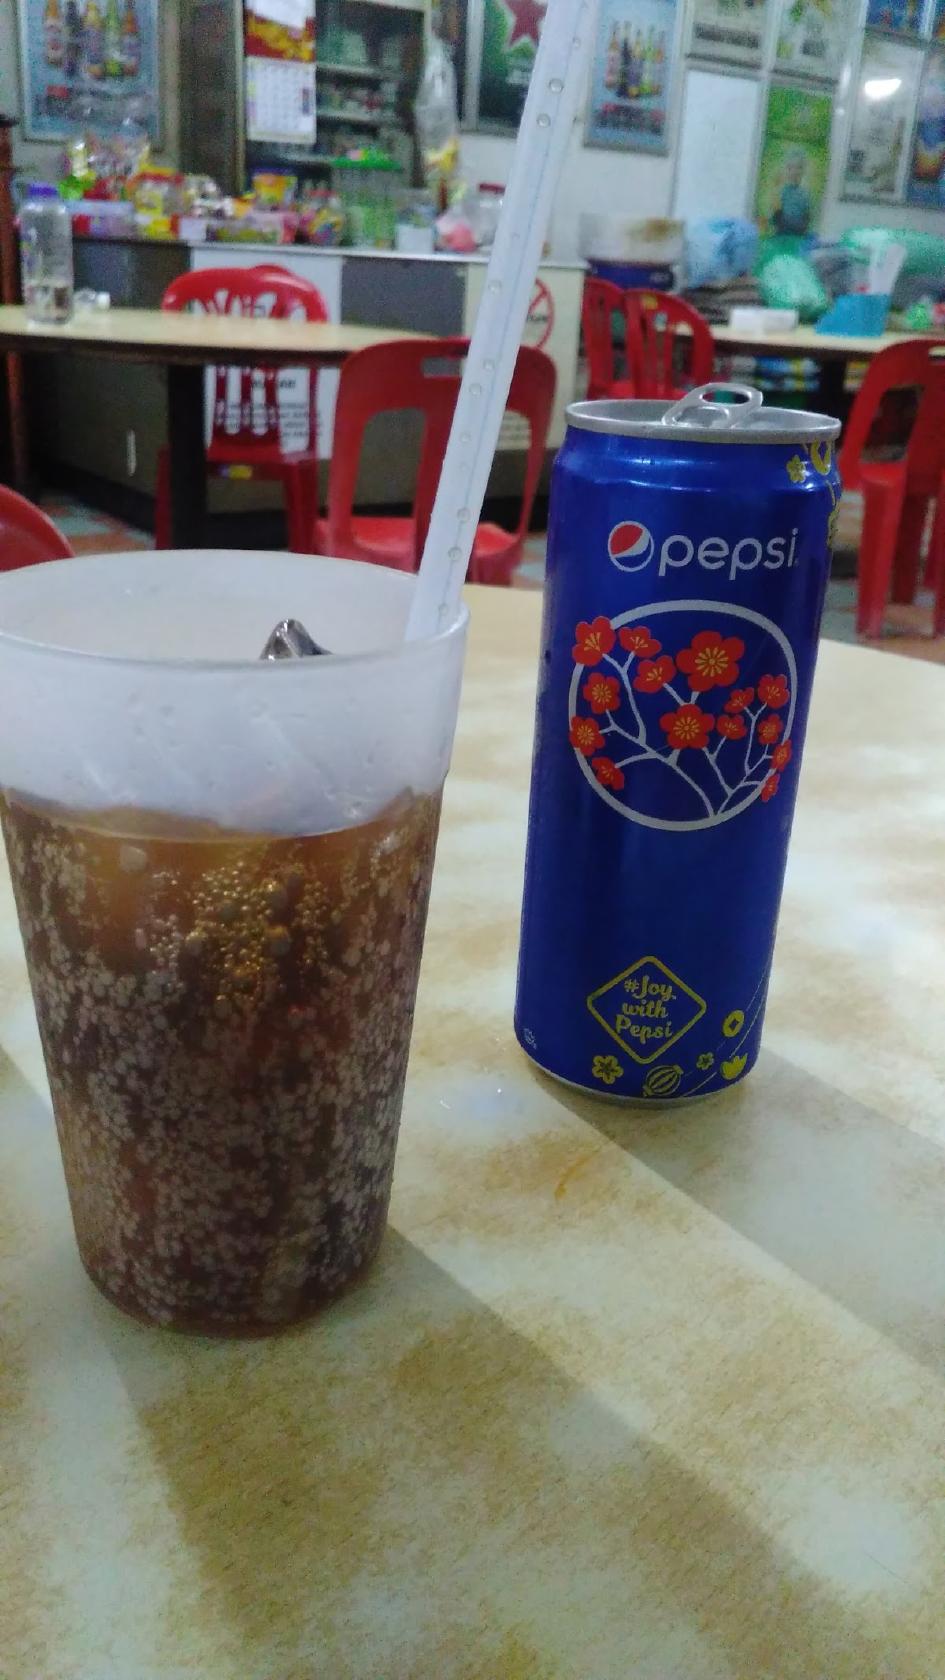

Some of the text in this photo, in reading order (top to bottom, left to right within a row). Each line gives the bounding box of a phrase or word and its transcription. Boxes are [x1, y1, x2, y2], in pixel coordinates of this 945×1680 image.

[658, 527, 798, 581] pepsi
[624, 975, 673, 1001] #Joy
[622, 999, 668, 1018] with
[616, 1014, 672, 1044] Pepsi
